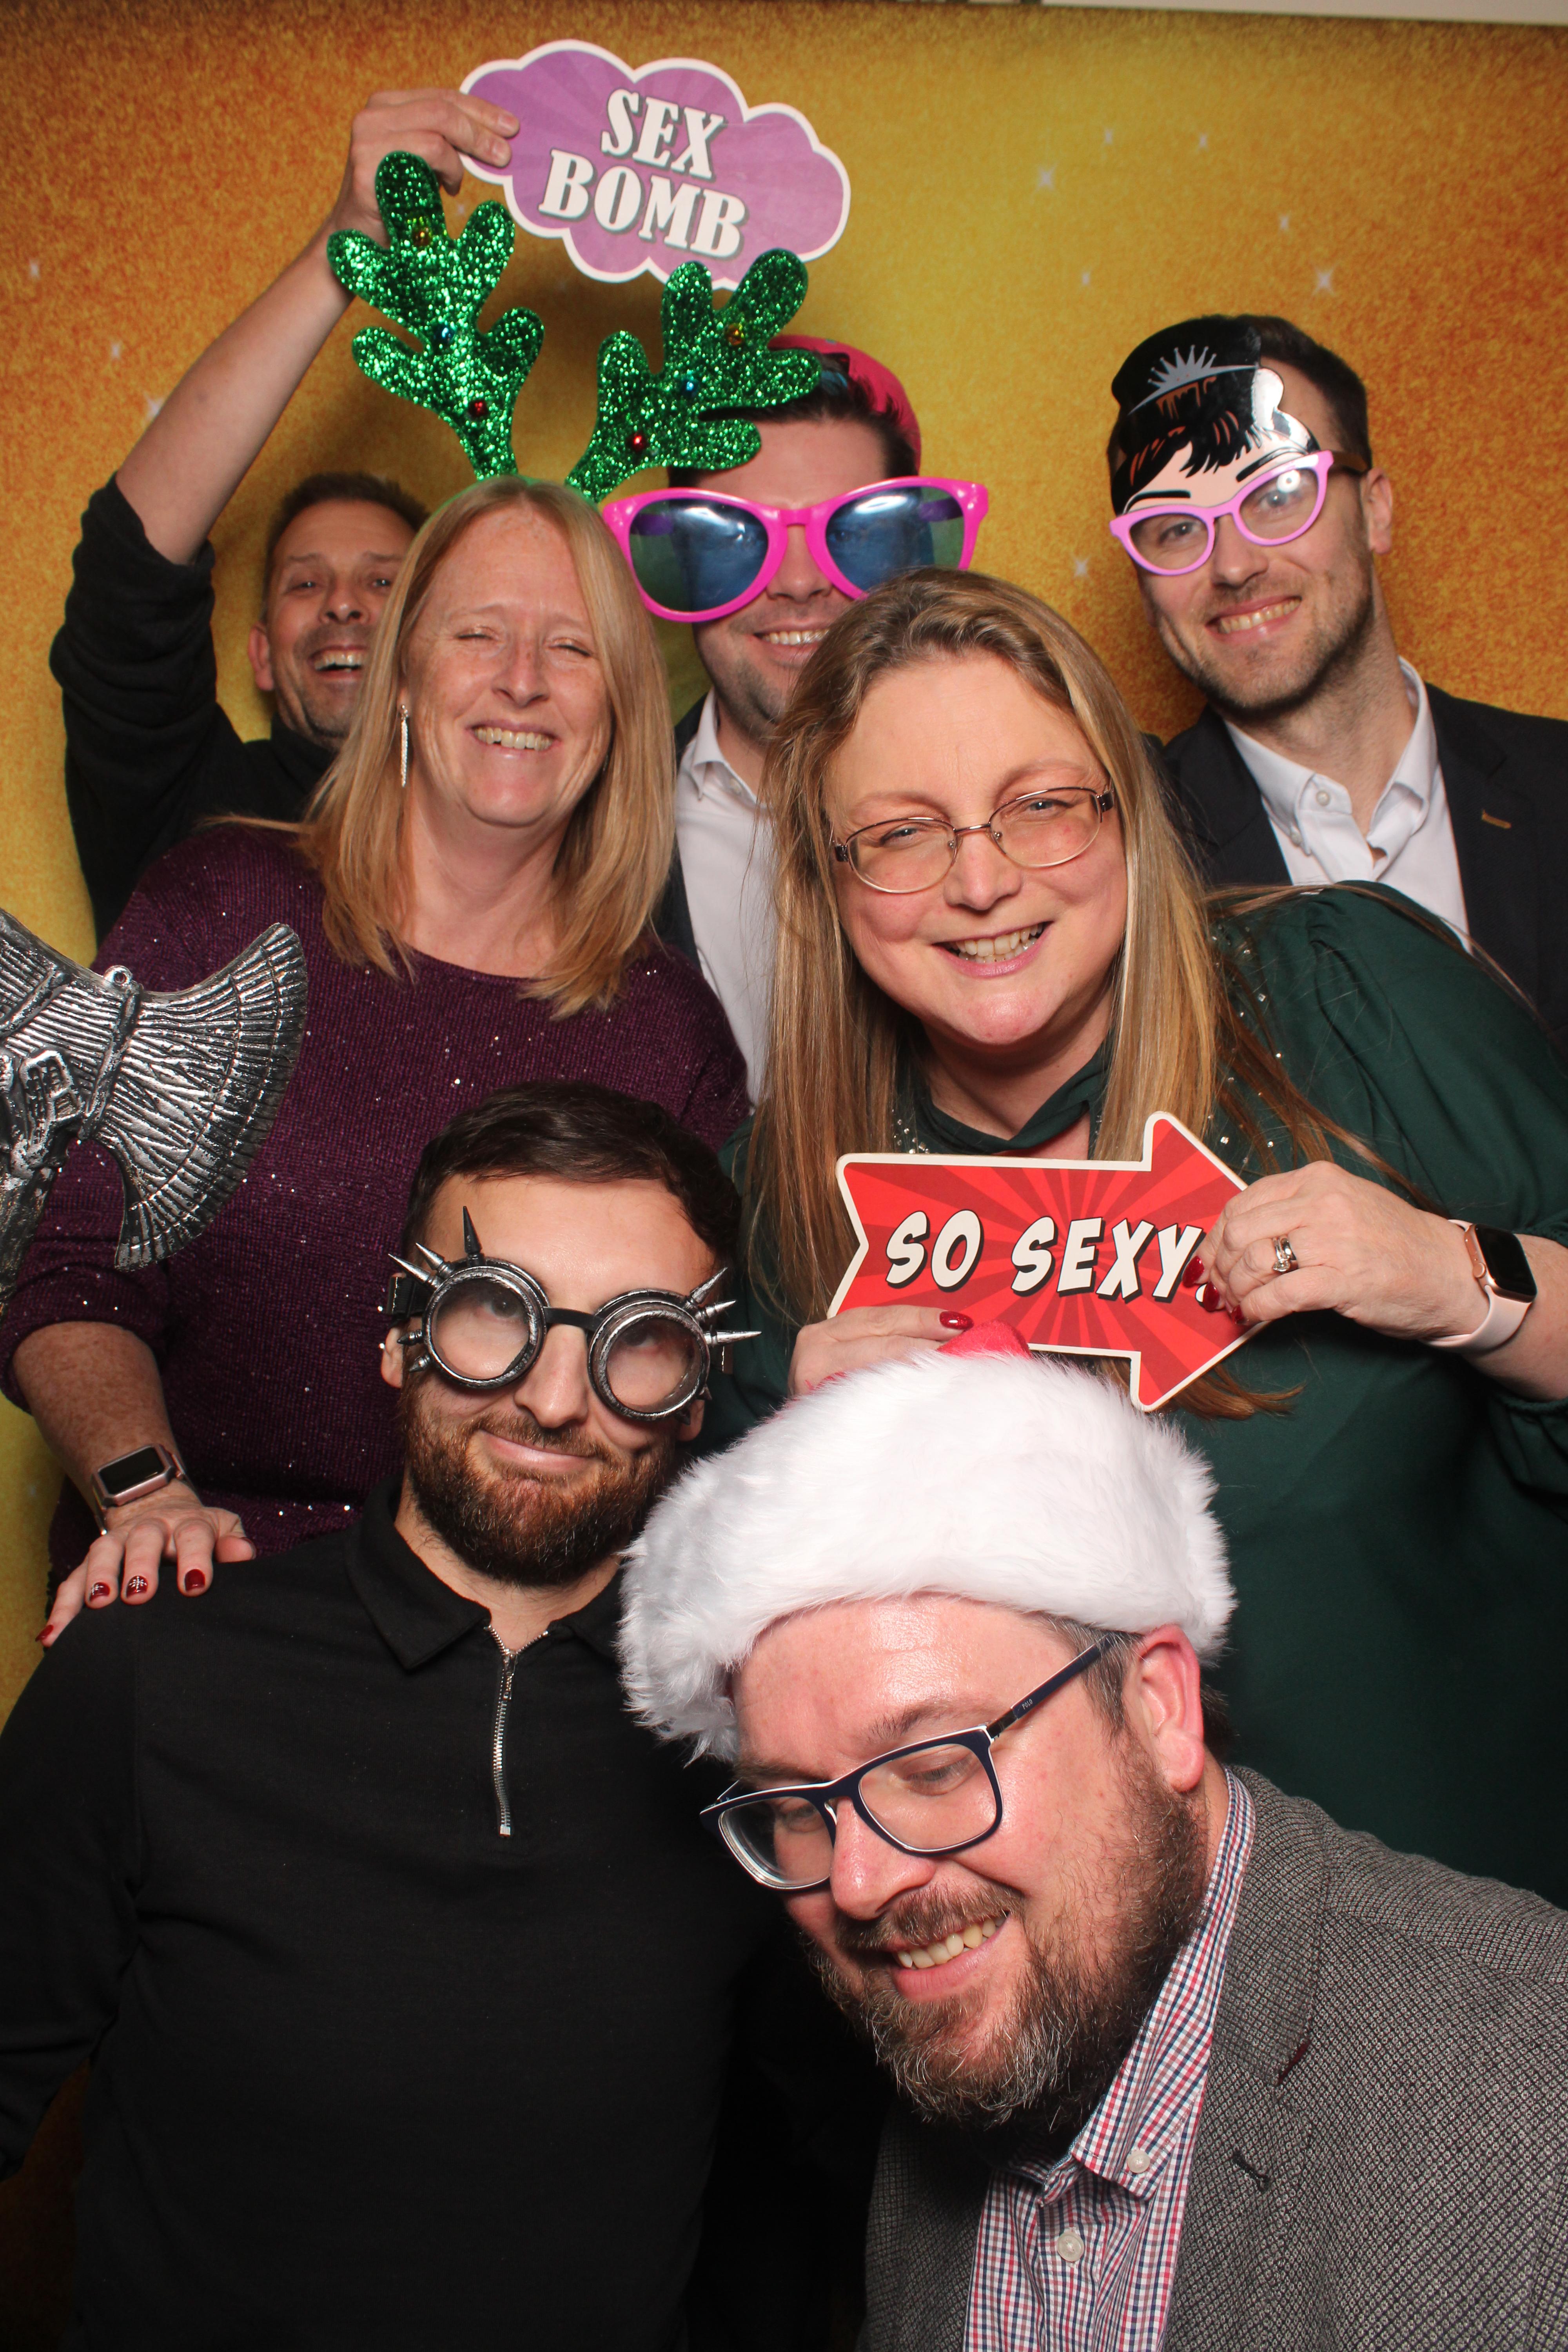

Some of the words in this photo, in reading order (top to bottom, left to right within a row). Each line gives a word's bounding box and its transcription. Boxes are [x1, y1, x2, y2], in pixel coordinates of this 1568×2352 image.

[601, 88, 727, 180] SEX
[538, 149, 749, 259] BOMB
[885, 1209, 983, 1290] SO
[1010, 1216, 1208, 1303] SEXY
[1022, 1699, 1033, 1710] POLO
